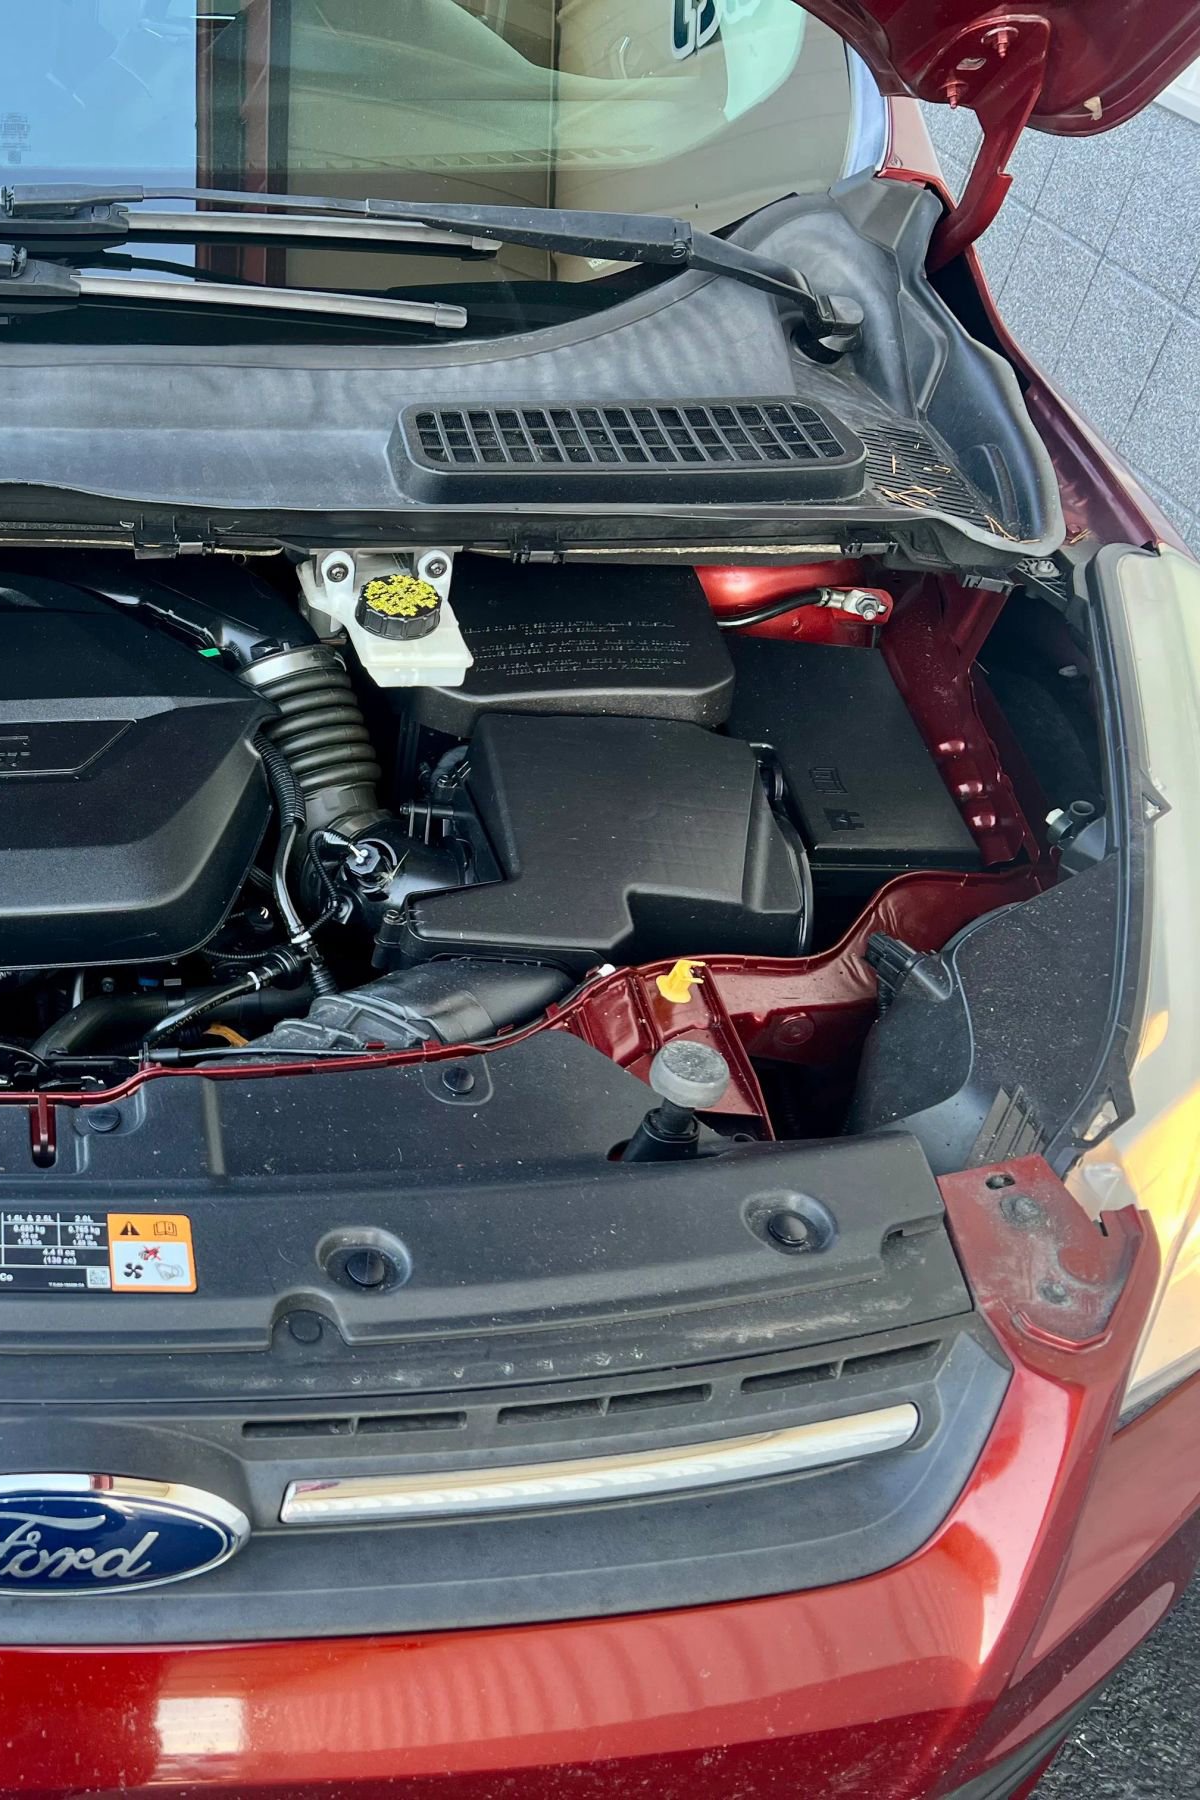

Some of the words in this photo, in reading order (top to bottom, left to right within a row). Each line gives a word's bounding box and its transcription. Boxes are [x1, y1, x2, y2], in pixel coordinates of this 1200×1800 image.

[74, 1214, 94, 1223] 2.0L
[35, 1225, 46, 1235] kg
[89, 1226, 101, 1236] kg
[42, 1247, 56, 1256] 4.4
[63, 1256, 77, 1265] cc)
